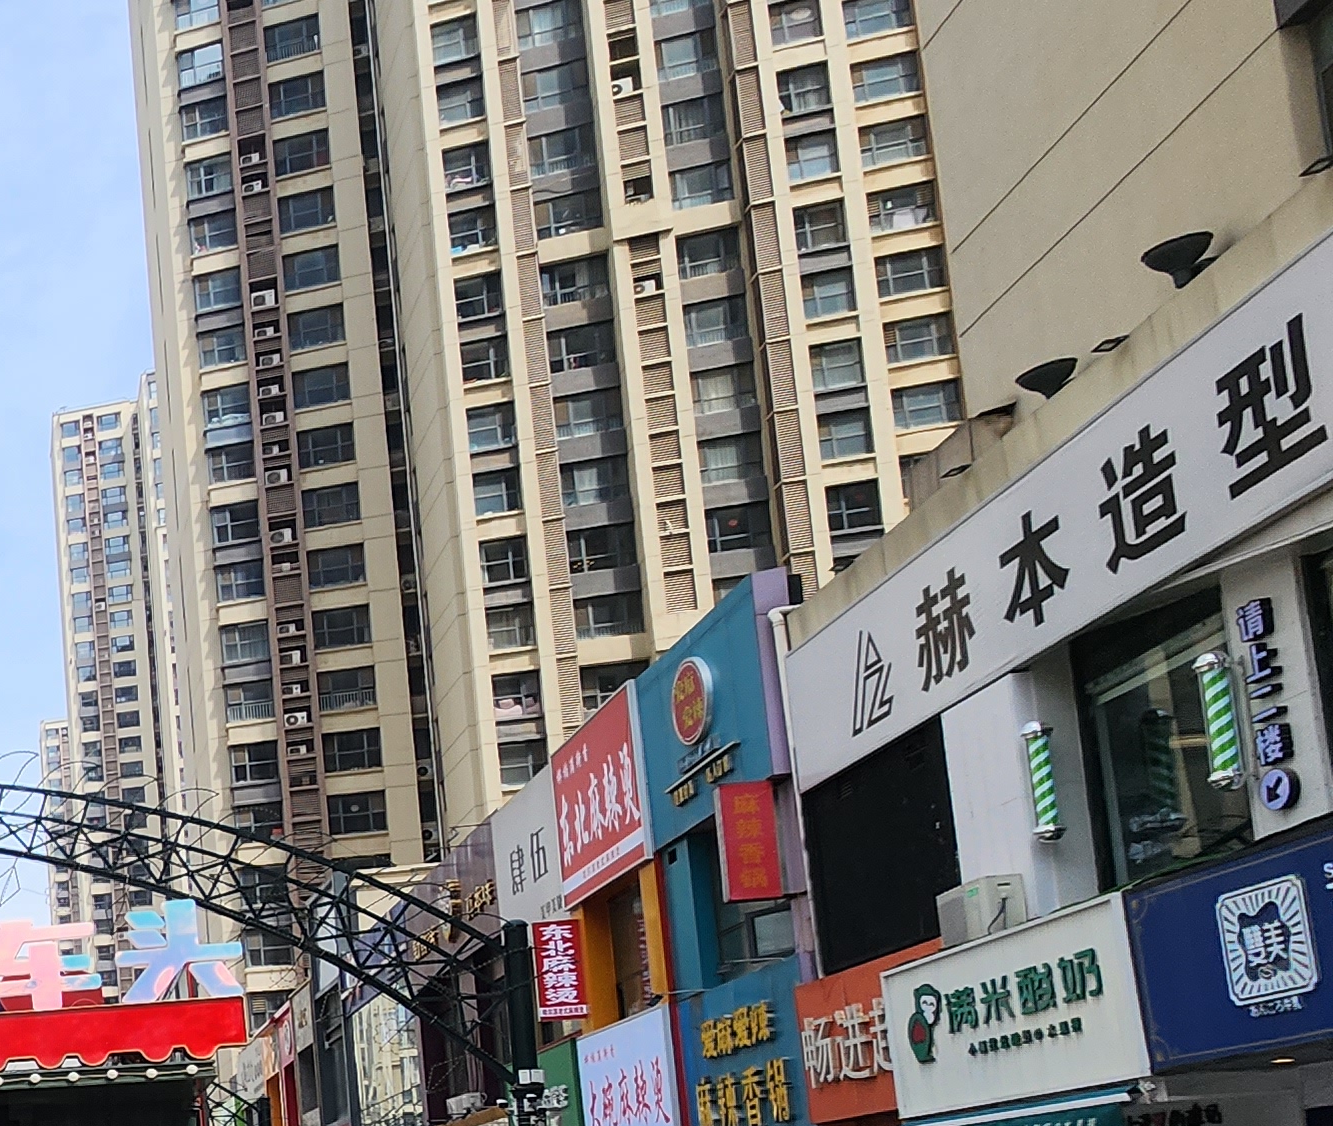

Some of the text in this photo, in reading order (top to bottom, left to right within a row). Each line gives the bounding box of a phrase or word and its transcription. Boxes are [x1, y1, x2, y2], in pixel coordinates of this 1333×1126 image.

[916, 313, 1328, 692] 赫本造型
[1236, 598, 1291, 767] 请上二楼
[538, 923, 581, 1006] 东北麻辣烫
[944, 948, 1104, 1034] 满米酸奶
